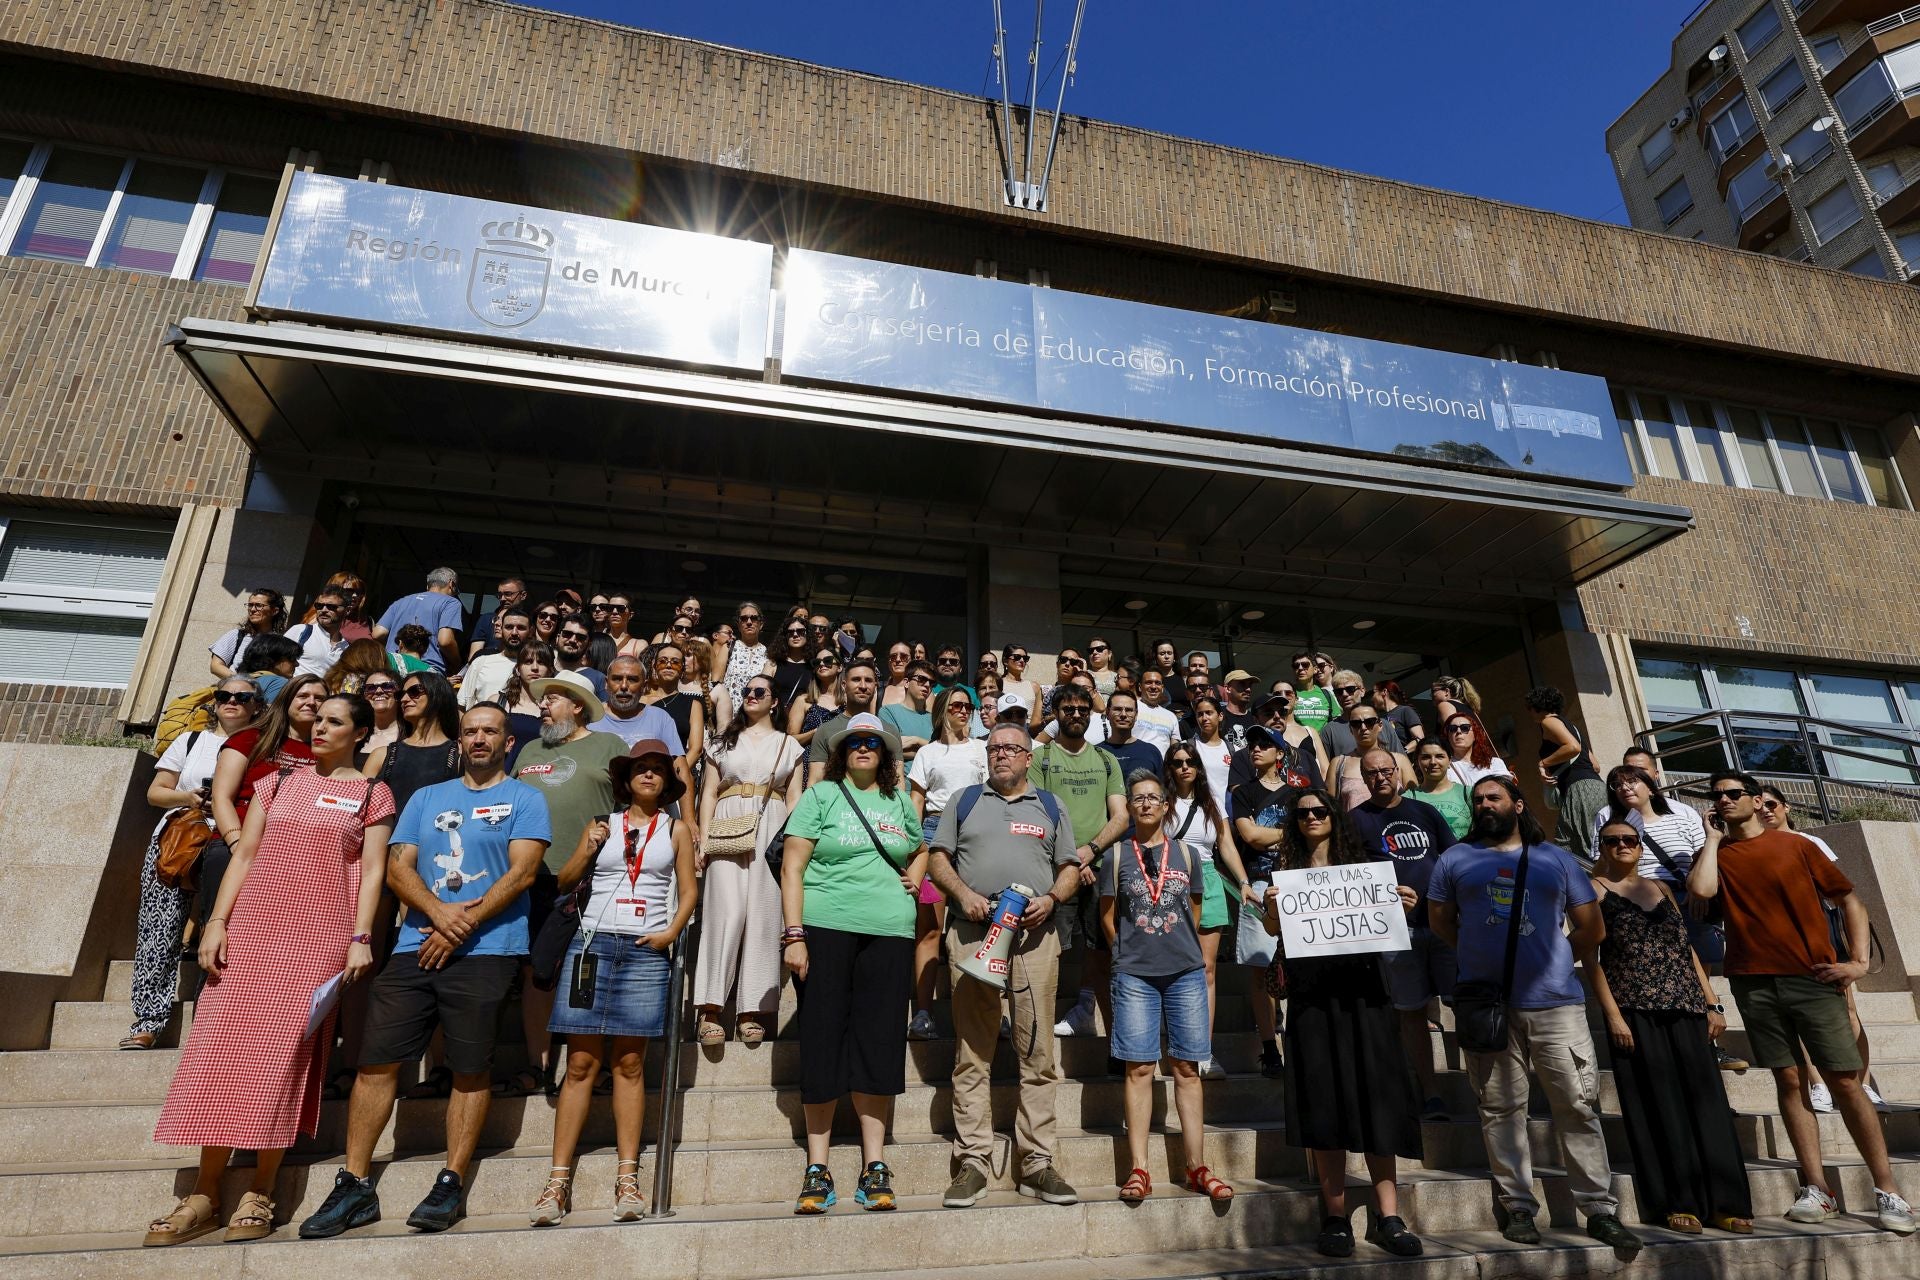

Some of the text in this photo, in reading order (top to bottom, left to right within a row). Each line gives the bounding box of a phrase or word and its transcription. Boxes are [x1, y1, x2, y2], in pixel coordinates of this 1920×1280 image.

[346, 229, 711, 300] Región de Murc
[819, 302, 981, 346] Consejería
[993, 328, 1028, 354] de
[1040, 335, 1194, 382] Educación,
[1205, 358, 1343, 400] Formación
[1350, 381, 1487, 421] Profesional
[1011, 822, 1044, 835] CCOO
[1386, 820, 1411, 830] ORIGINAL
[1306, 867, 1373, 886] POR UNAS
[1281, 883, 1399, 915] OPOSICIONES
[978, 926, 1001, 960] CCOO
[1301, 911, 1389, 944] JUSTAS
